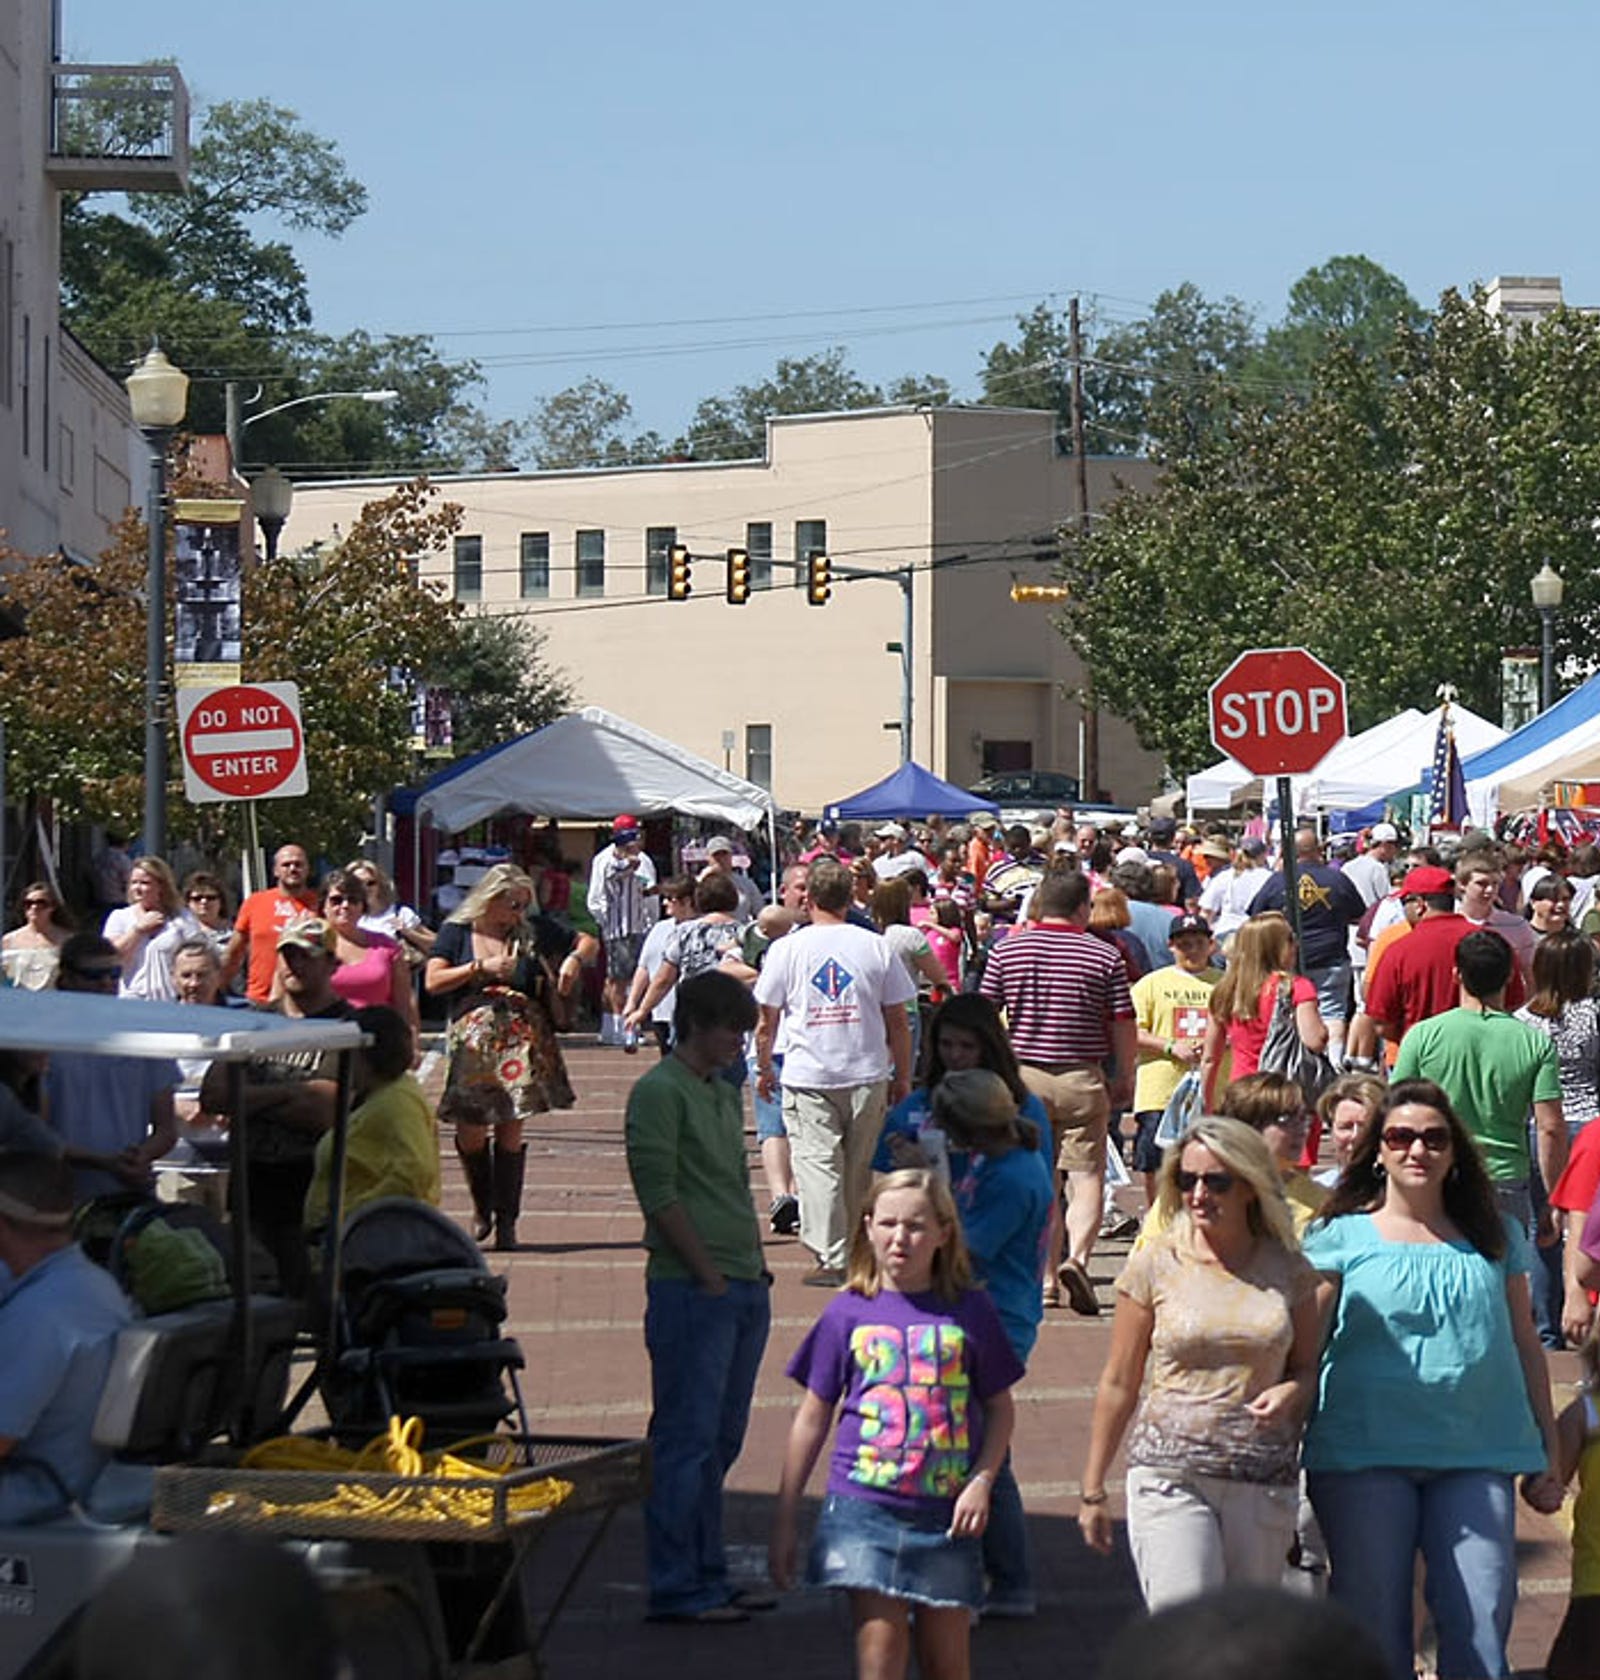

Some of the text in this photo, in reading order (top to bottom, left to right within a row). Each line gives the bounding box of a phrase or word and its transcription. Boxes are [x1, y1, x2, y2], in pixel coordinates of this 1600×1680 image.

[199, 706, 281, 728] DO NOT
[1220, 687, 1336, 739] STOP
[211, 756, 279, 778] ENTER
